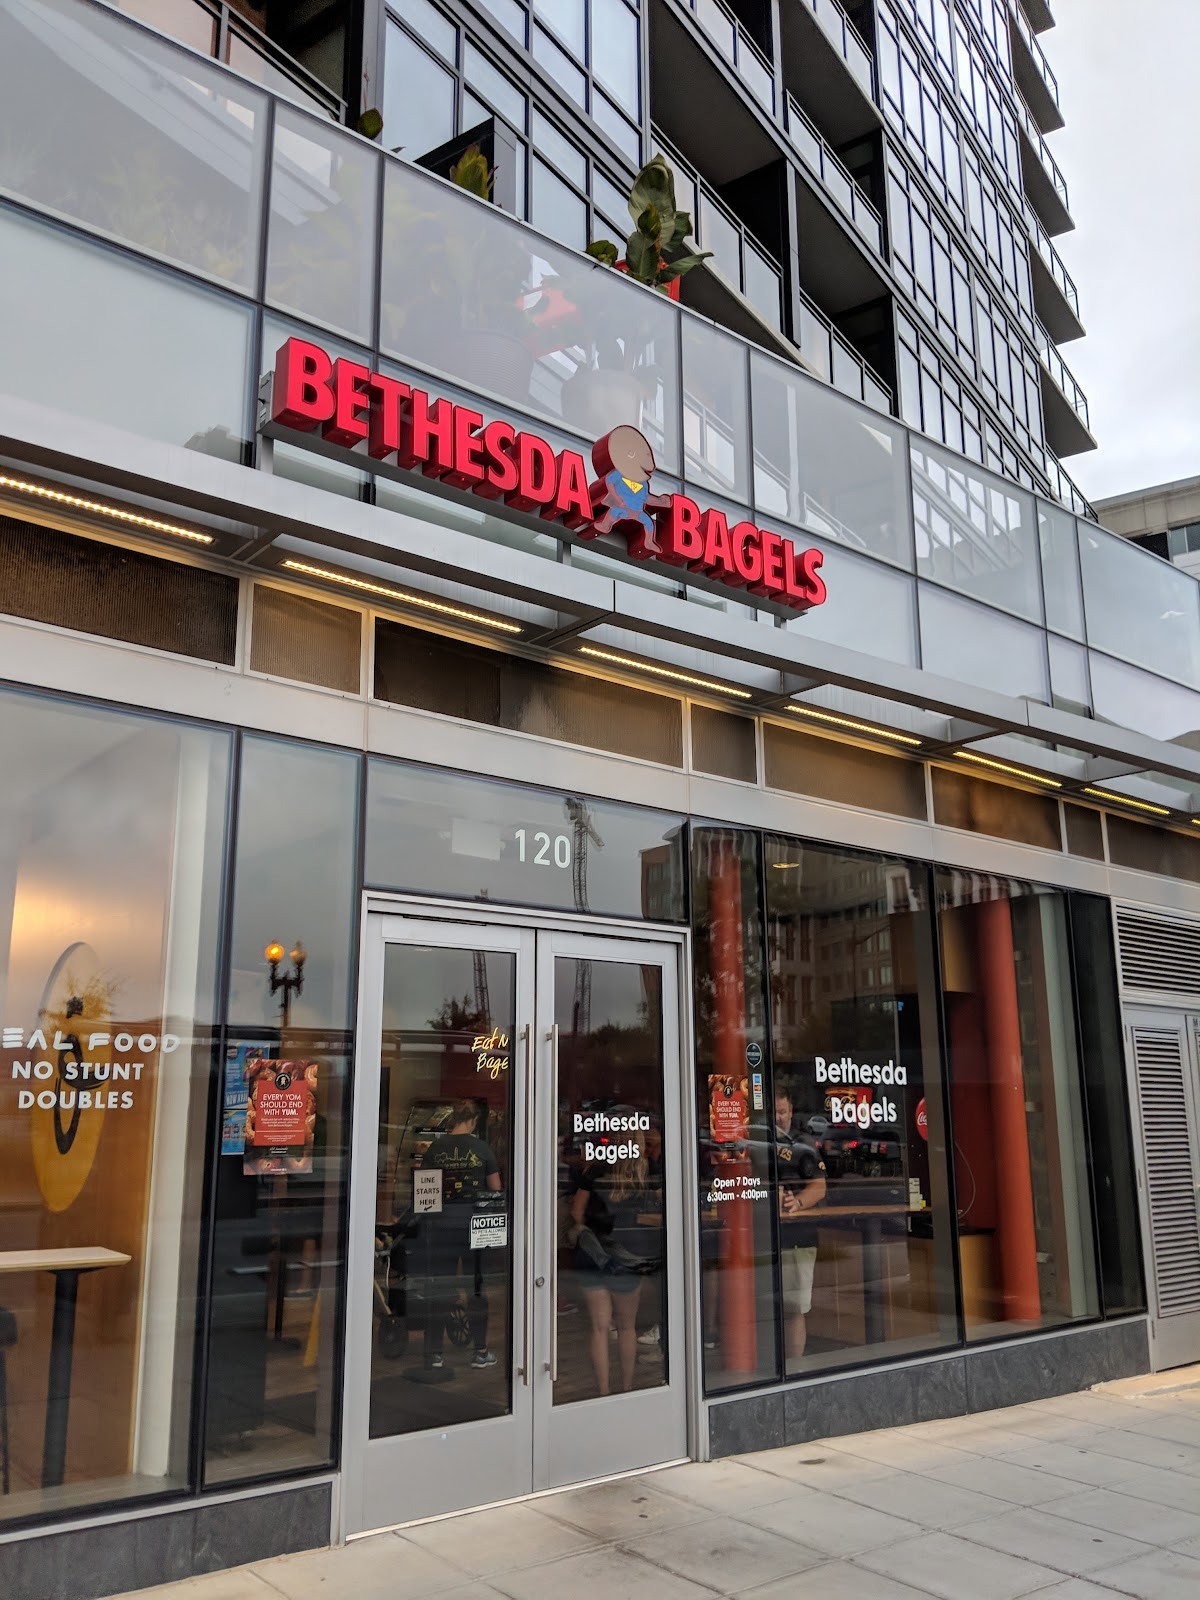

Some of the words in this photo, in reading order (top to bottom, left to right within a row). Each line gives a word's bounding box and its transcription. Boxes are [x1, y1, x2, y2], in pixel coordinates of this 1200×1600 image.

[276, 336, 594, 524] BETHESDA
[669, 493, 826, 605] BAGELS
[515, 829, 571, 868] 120
[88, 1032, 181, 1053] FOOD
[12, 1061, 54, 1079] NO
[64, 1062, 144, 1080] STUNT
[815, 1056, 908, 1085] Bethesda
[18, 1090, 134, 1109] DOUBLES
[263, 1093, 284, 1101] EVERY
[285, 1093, 301, 1101] YOM
[573, 1112, 650, 1133] Bethesda
[830, 1096, 898, 1130] Bagels
[585, 1139, 640, 1164] Bagels
[416, 1187, 440, 1195] STARTS
[713, 1177, 735, 1190] Open
[736, 1176, 741, 1186] 7
[742, 1176, 760, 1187] Days
[706, 1191, 735, 1202] 6:30am
[740, 1189, 768, 1201] 4:00pm
[473, 1216, 505, 1228] NOTICE
